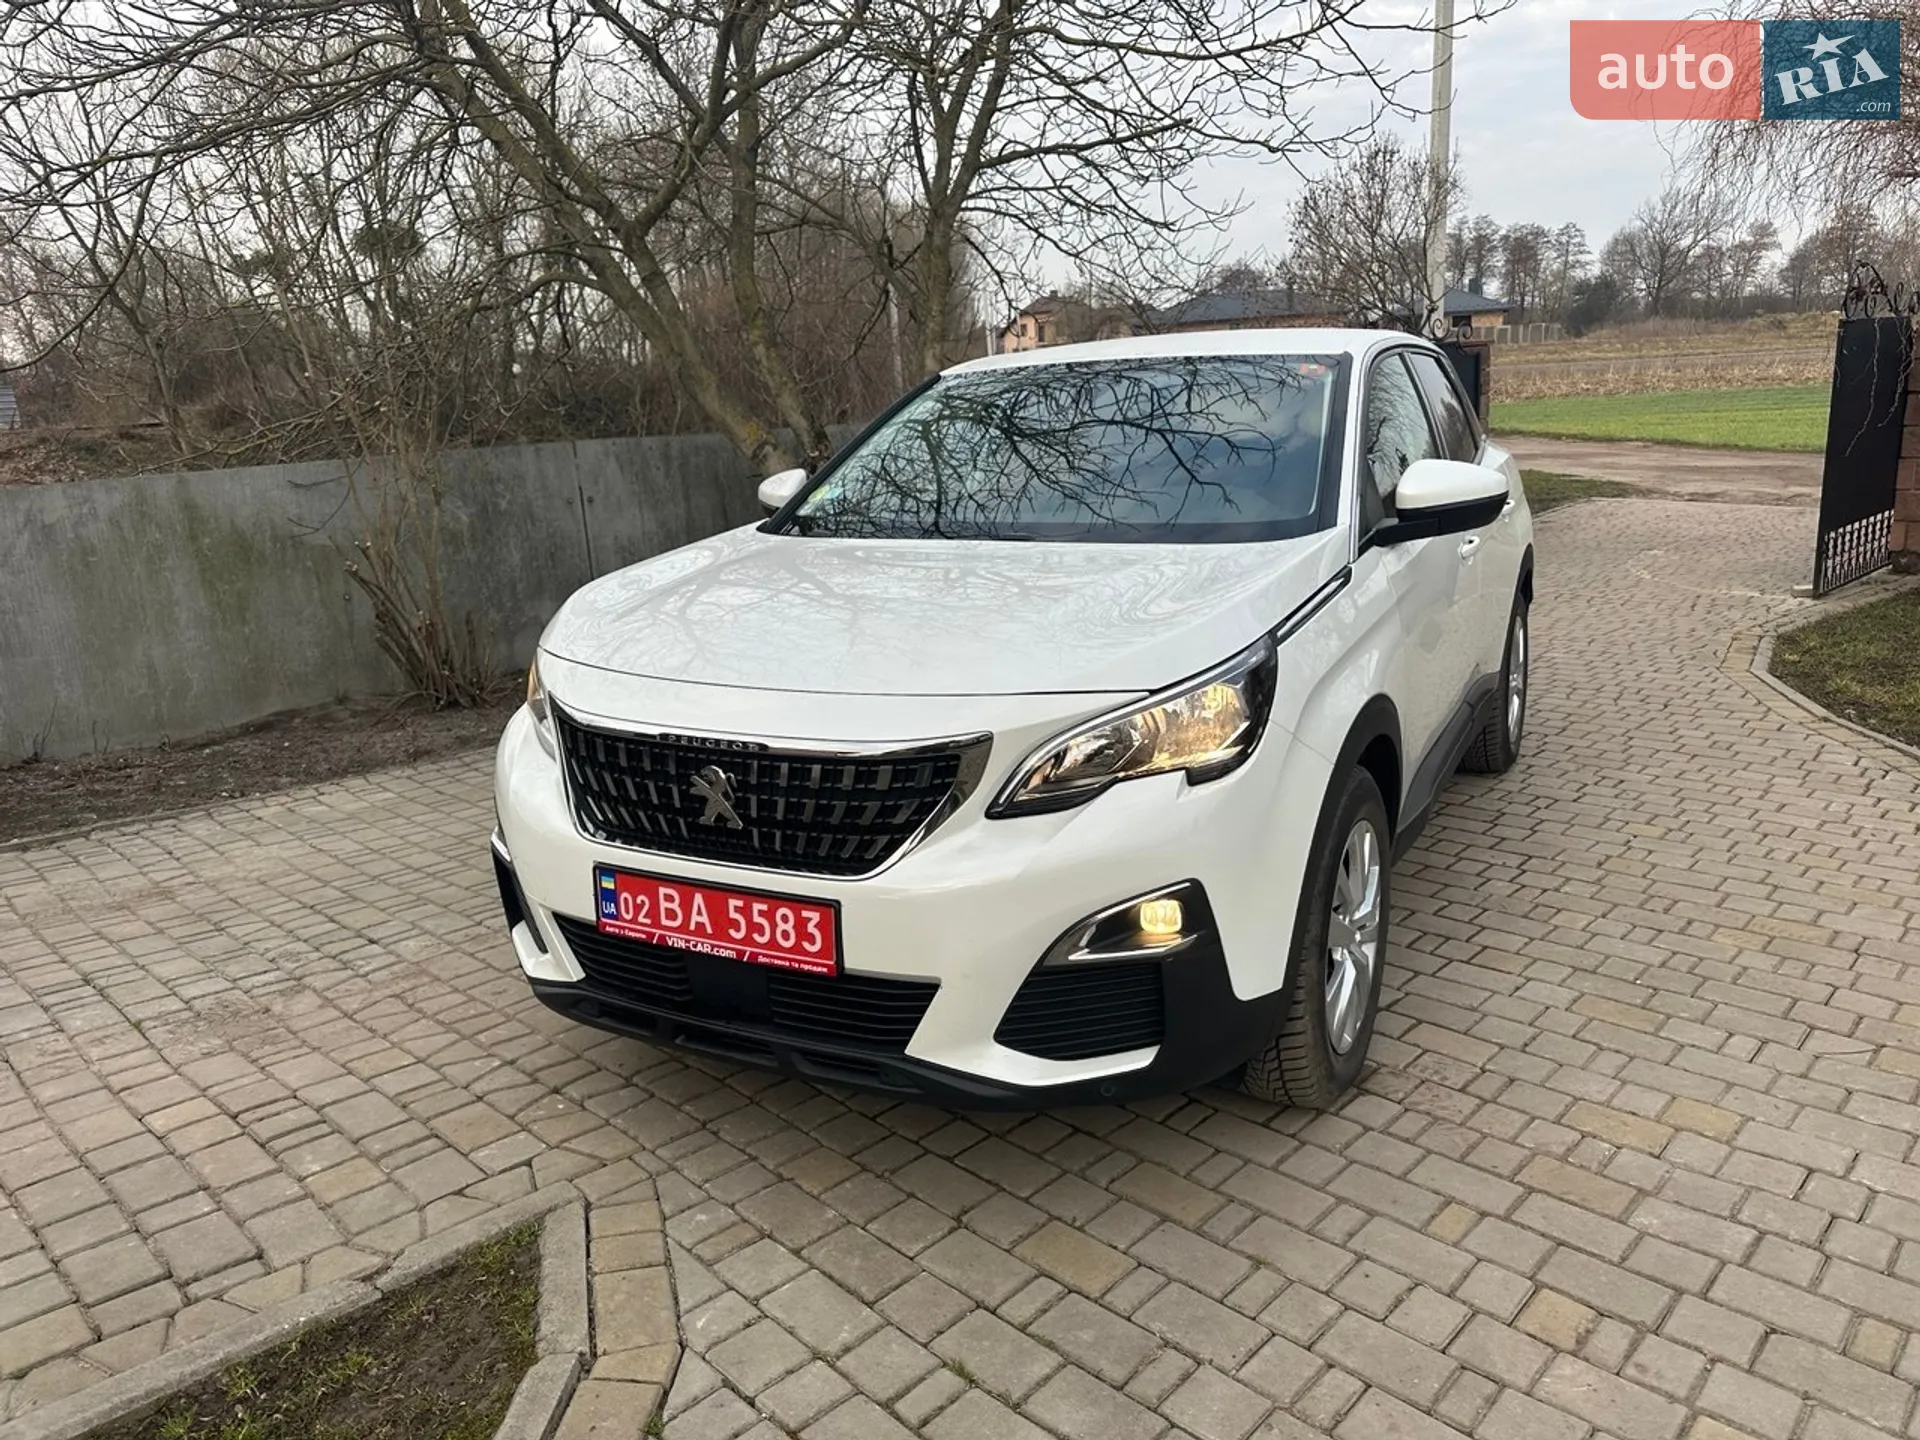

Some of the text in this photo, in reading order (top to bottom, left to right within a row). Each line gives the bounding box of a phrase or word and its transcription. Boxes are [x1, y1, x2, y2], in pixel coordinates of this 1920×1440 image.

[668, 735, 759, 751] PEUGEOT
[602, 901, 617, 915] UA
[620, 886, 822, 952] 02 BA 5583
[666, 936, 737, 958] VIN-CAR.com
